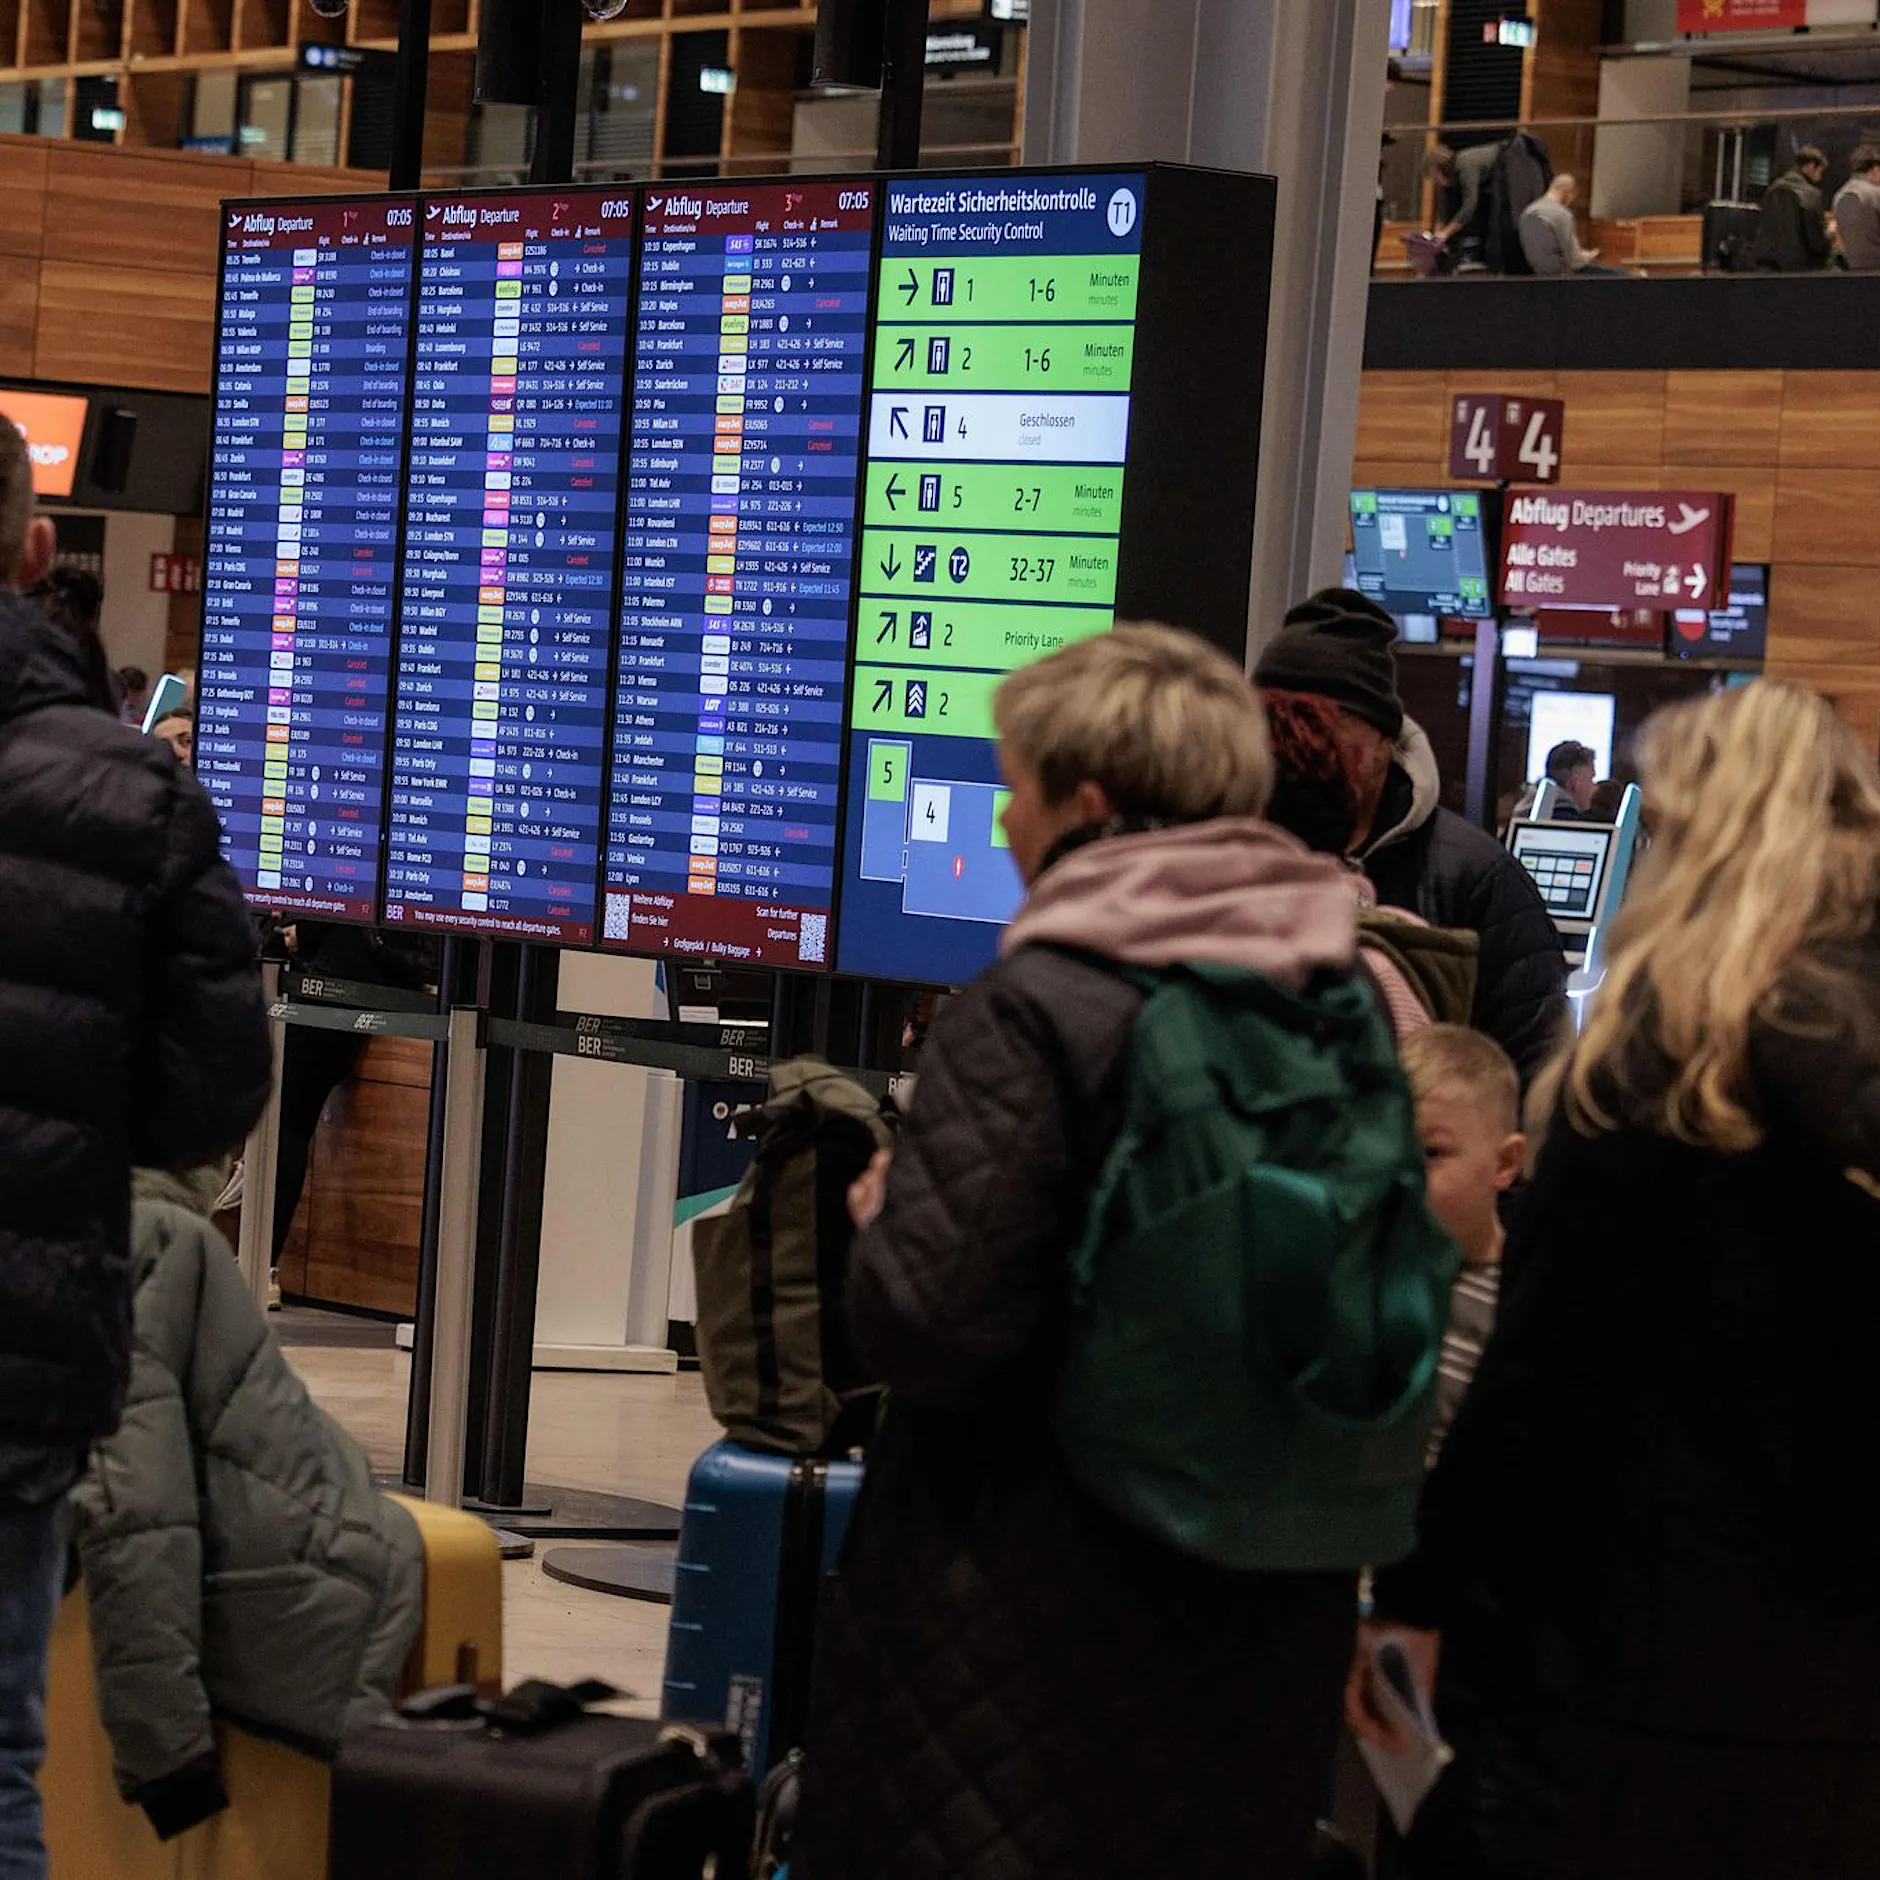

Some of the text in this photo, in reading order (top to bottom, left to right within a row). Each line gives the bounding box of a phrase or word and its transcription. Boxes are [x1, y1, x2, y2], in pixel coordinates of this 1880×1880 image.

[601, 201, 629, 218] 07:05
[665, 197, 749, 220] Abflug Departure
[839, 192, 869, 210] 07:05
[891, 188, 1096, 214] Wartezeit Sicherheitskontrolle
[387, 209, 412, 226] 07:05
[443, 206, 520, 228] Abflug Departure
[1114, 202, 1130, 224] T1
[243, 214, 313, 236] Abflug Departure
[889, 222, 1044, 246] Waiting Time Security Control
[663, 242, 696, 253] Copenhagen
[730, 240, 742, 250] SAS
[661, 261, 680, 271] Dublin
[660, 282, 694, 293] Birmingham
[1090, 273, 1129, 287] Minuten
[438, 287, 463, 296] Barcelona
[967, 279, 973, 301] 1
[1029, 279, 1054, 302] 1-6
[1088, 296, 1118, 306] minutes
[658, 320, 685, 330] Barcelona
[657, 340, 684, 350] Frankfurt
[813, 339, 825, 349] Self
[826, 340, 844, 349] Service
[1084, 344, 1124, 357] Minuten
[434, 361, 458, 372] Frankfurt
[656, 360, 674, 370] Zurich
[812, 359, 824, 369] Self
[825, 360, 843, 369] Service
[962, 348, 971, 370] 2
[1024, 349, 1050, 372] 1-6
[1083, 366, 1112, 377] minutes
[653, 400, 665, 410] Pisa
[958, 417, 968, 439] 4
[1020, 413, 1075, 428] Geschlossen
[652, 439, 672, 449] London
[1018, 434, 1041, 446] closed
[1465, 407, 1495, 474] 4
[1518, 411, 1558, 479] 4
[650, 459, 678, 471] Edinburgh
[426, 494, 457, 504] Copenhagen
[954, 486, 962, 508] 5
[1014, 488, 1041, 512] 2-7
[1074, 485, 1113, 499] Minuten
[1073, 506, 1102, 518] minutes
[1510, 498, 1666, 532] Abflug Departures
[803, 522, 827, 533] Expected
[646, 538, 666, 548] London
[802, 542, 825, 554] Expected
[1069, 556, 1108, 570] Minuten
[1506, 543, 1577, 568] Alle Gates
[813, 564, 831, 574] Service
[951, 555, 967, 576] T2
[1010, 558, 1055, 582] 32-37
[1623, 562, 1661, 580] Priority
[800, 584, 823, 596] Expected
[1068, 578, 1097, 589] minutes
[1505, 570, 1565, 594] All Gates
[1636, 581, 1660, 596] Lane
[944, 624, 953, 646] 2
[1005, 632, 1063, 650] Priority Lane
[939, 692, 948, 716] 2
[883, 761, 892, 783] 5
[927, 801, 935, 823] 4
[627, 853, 645, 864] Venice
[626, 873, 640, 884] Lyon
[386, 906, 403, 921] BER
[756, 906, 799, 920] Scan for further
[767, 929, 797, 941] Departures
[302, 978, 324, 996] BER
[354, 1014, 374, 1029] BER
[576, 1016, 600, 1033] BER
[578, 1036, 601, 1055] BER
[721, 1029, 745, 1046] BER
[729, 1057, 754, 1078] BER
